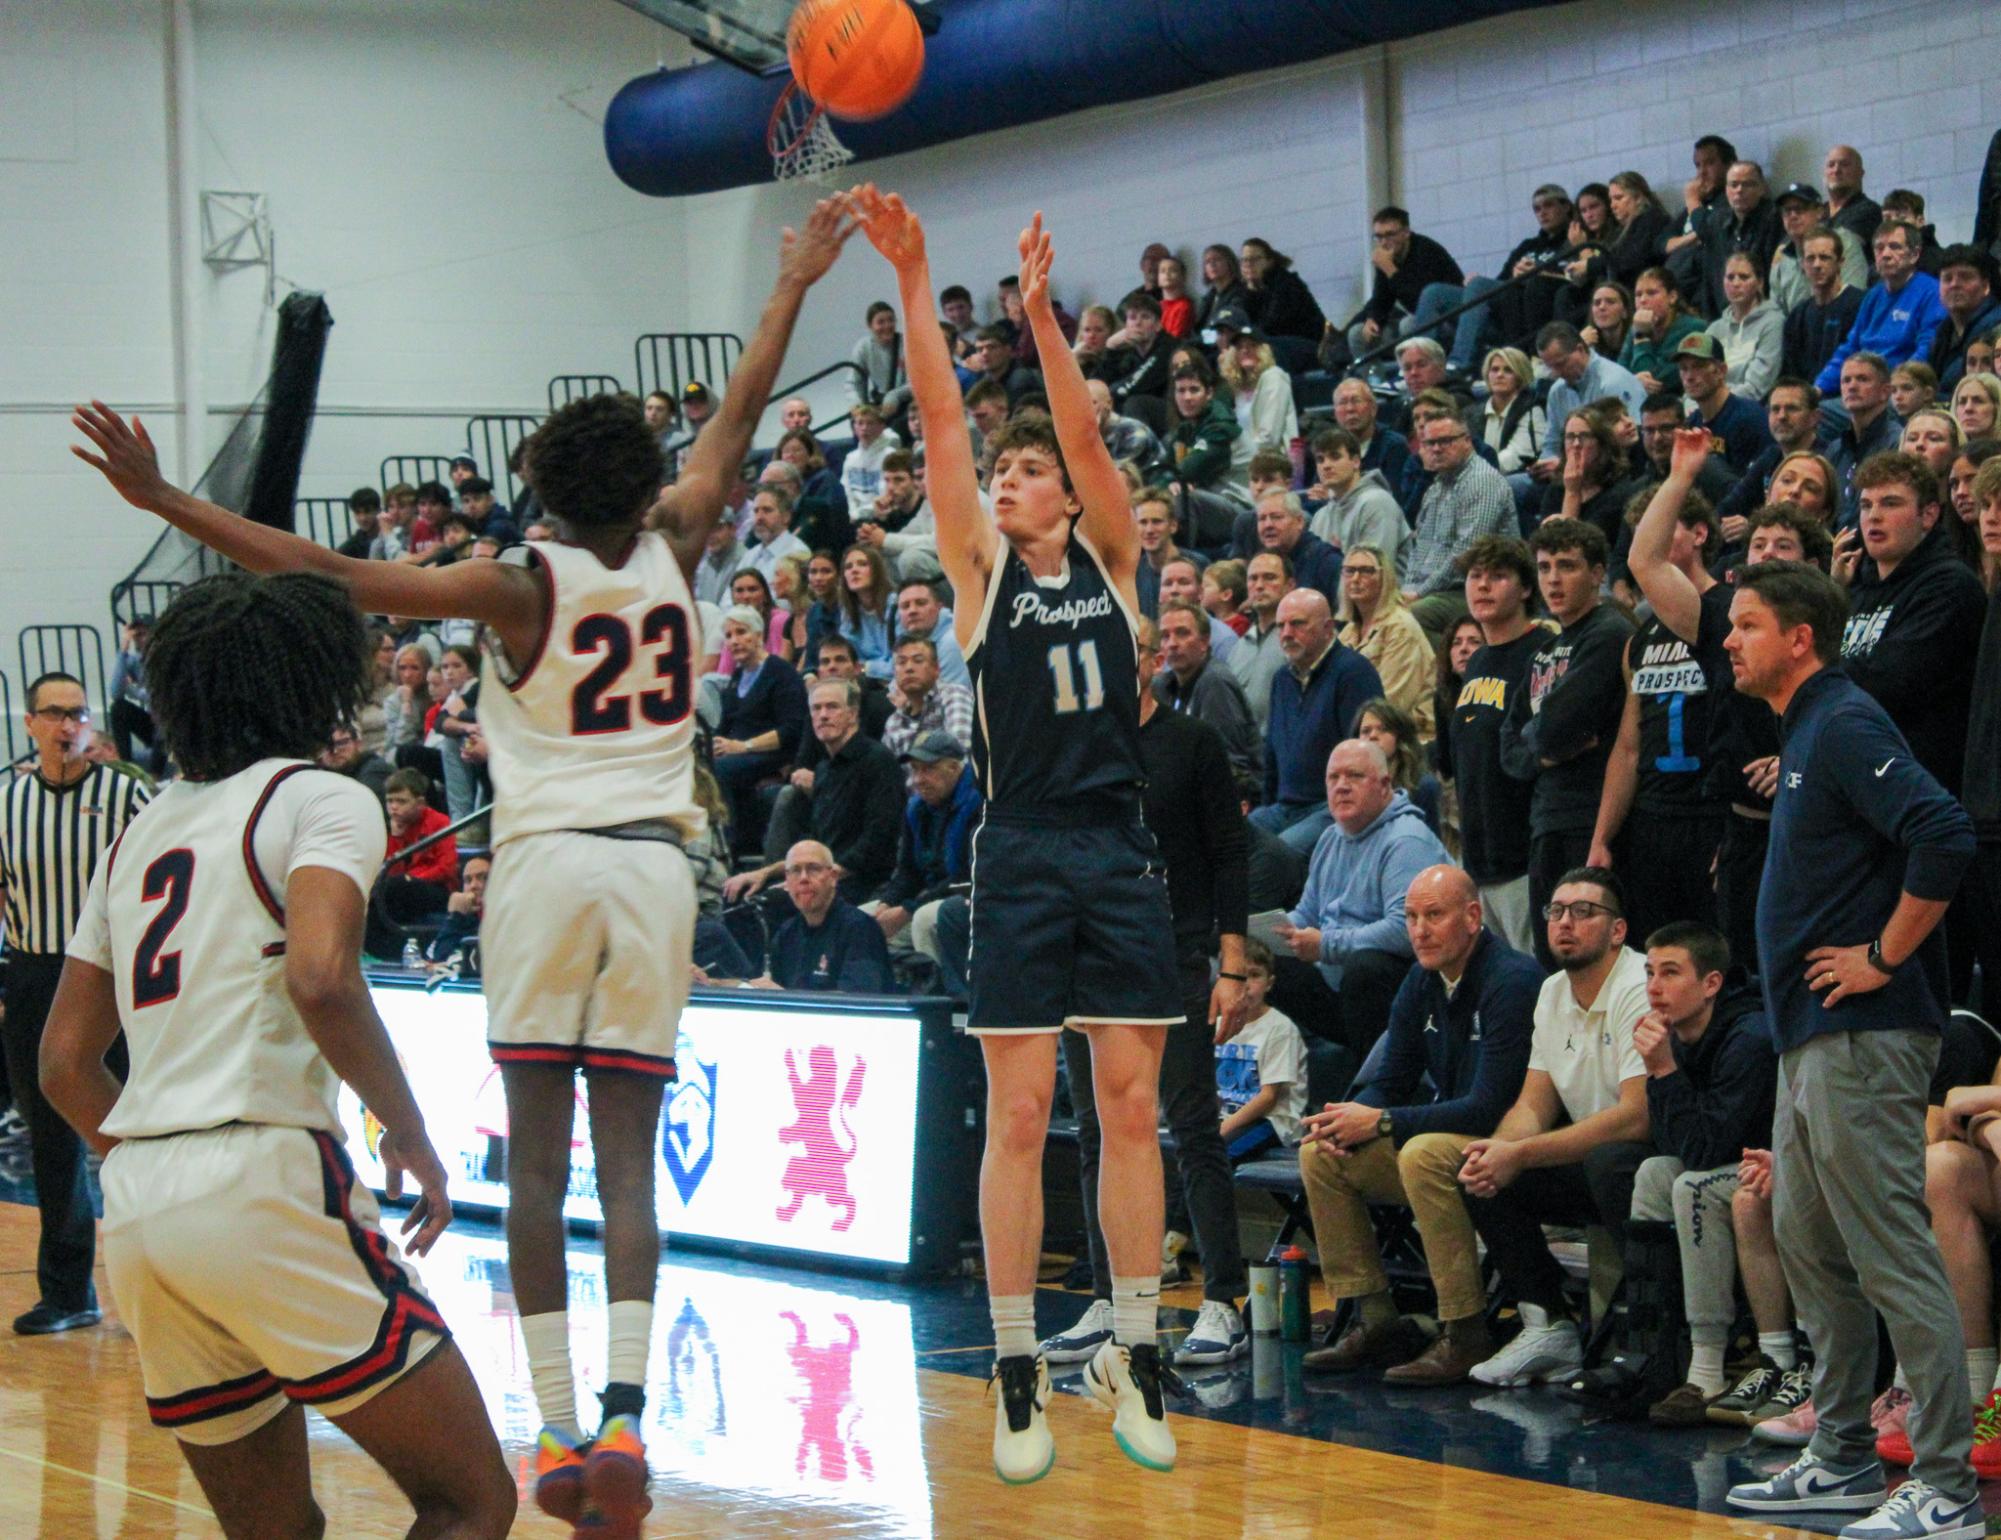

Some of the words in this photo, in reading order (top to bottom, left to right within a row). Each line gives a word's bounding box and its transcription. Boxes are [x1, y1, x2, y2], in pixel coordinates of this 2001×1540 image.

[1009, 589, 1112, 629] Prospect
[571, 602, 693, 736] 23
[1048, 639, 1105, 714] 11
[1637, 669, 1708, 690] PROSPEC
[1641, 641, 1691, 666] MIA
[1655, 691, 1701, 772] 1
[132, 847, 195, 1010] 2
